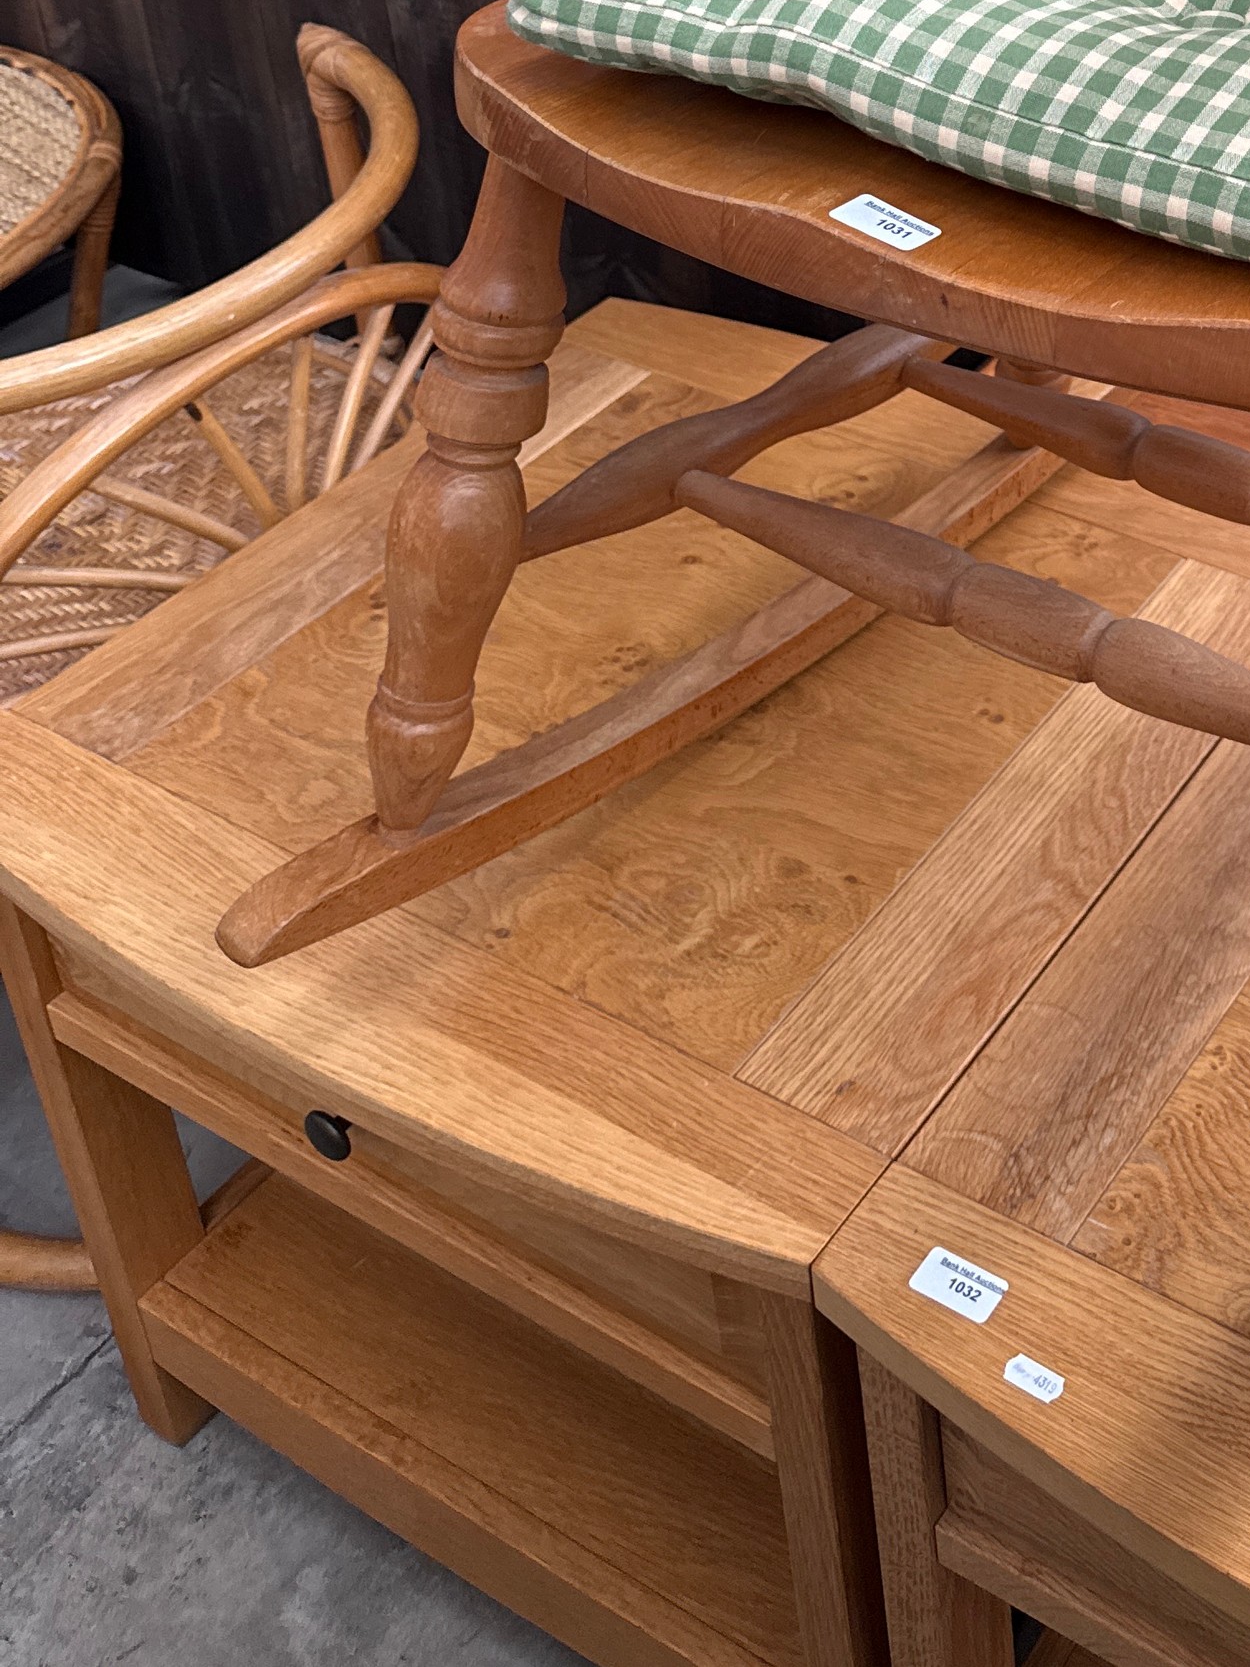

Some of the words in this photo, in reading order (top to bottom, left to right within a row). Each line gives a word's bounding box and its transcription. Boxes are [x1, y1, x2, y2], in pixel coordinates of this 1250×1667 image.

[864, 200, 886, 216] Bank
[901, 218, 935, 237] Auctions
[876, 218, 913, 239] 1031
[940, 1256, 960, 1273] Bank
[960, 1266, 975, 1281] Hall
[948, 1277, 982, 1303] 1032
